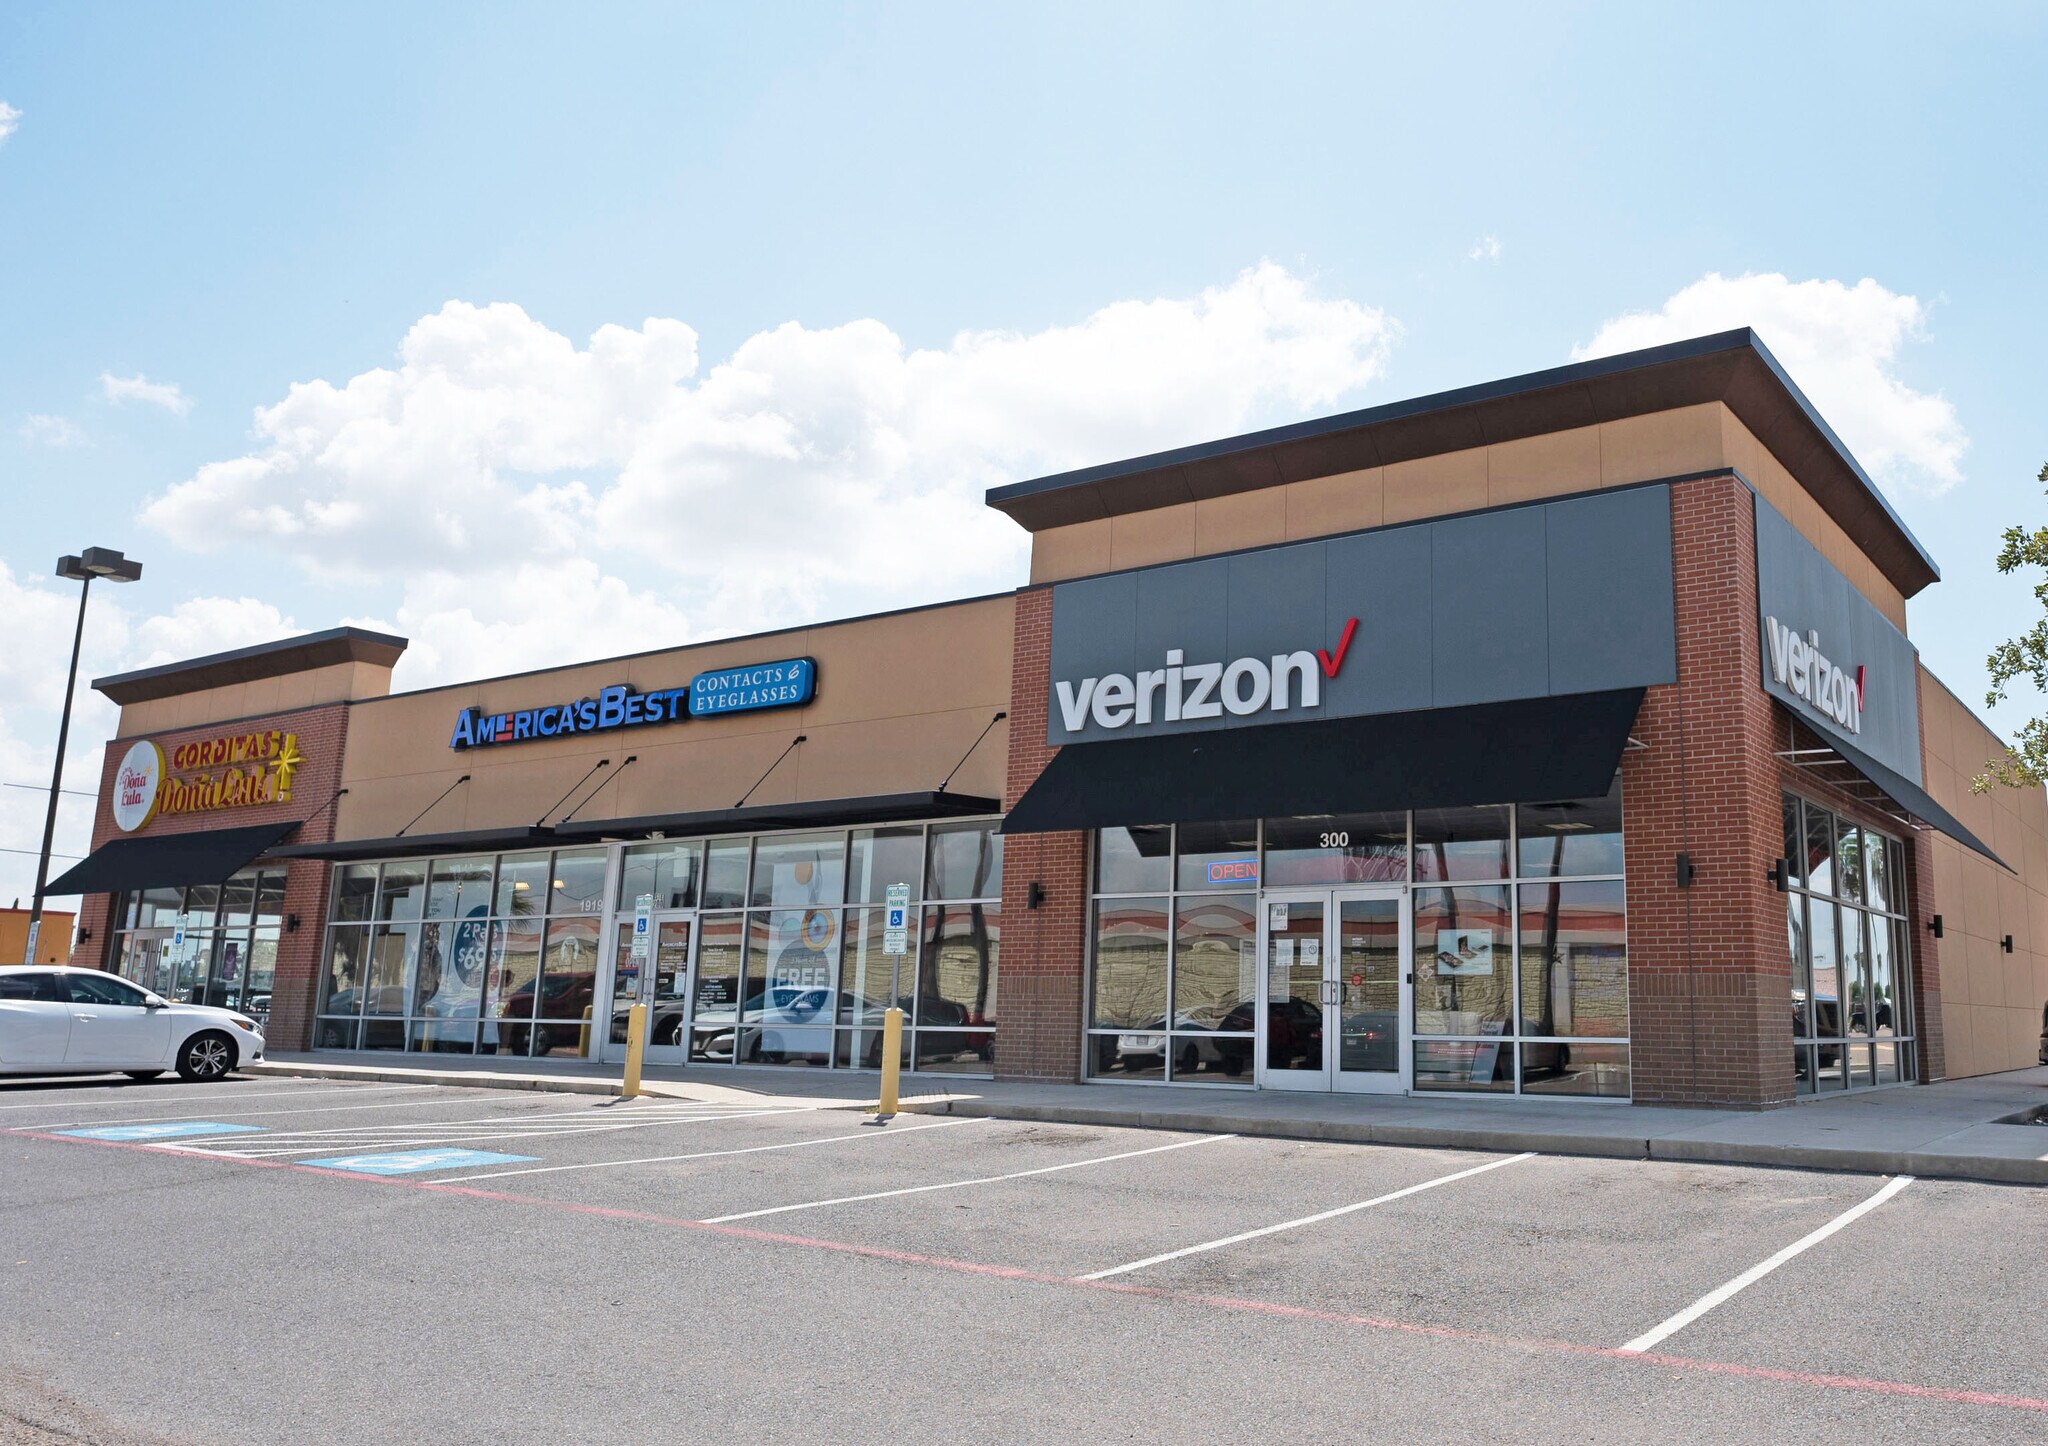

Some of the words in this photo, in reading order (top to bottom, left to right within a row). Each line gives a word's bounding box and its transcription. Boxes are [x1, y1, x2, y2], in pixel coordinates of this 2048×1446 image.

[696, 668, 782, 693] CONTACTS
[1766, 615, 1860, 735] verizon
[696, 684, 798, 711] EYEGLASSES
[1056, 648, 1320, 732] verizon
[450, 700, 597, 748] AMERICA'S
[600, 685, 685, 728] BEST
[174, 731, 274, 769] GORDITAS
[123, 772, 147, 790] Doña
[157, 774, 216, 814] Doña
[1320, 831, 1349, 848] 300
[1210, 862, 1257, 881] OPEN
[580, 899, 604, 912] 1919
[463, 922, 471, 938] 2
[777, 967, 826, 989] FREE
[781, 994, 793, 1004] EYE
